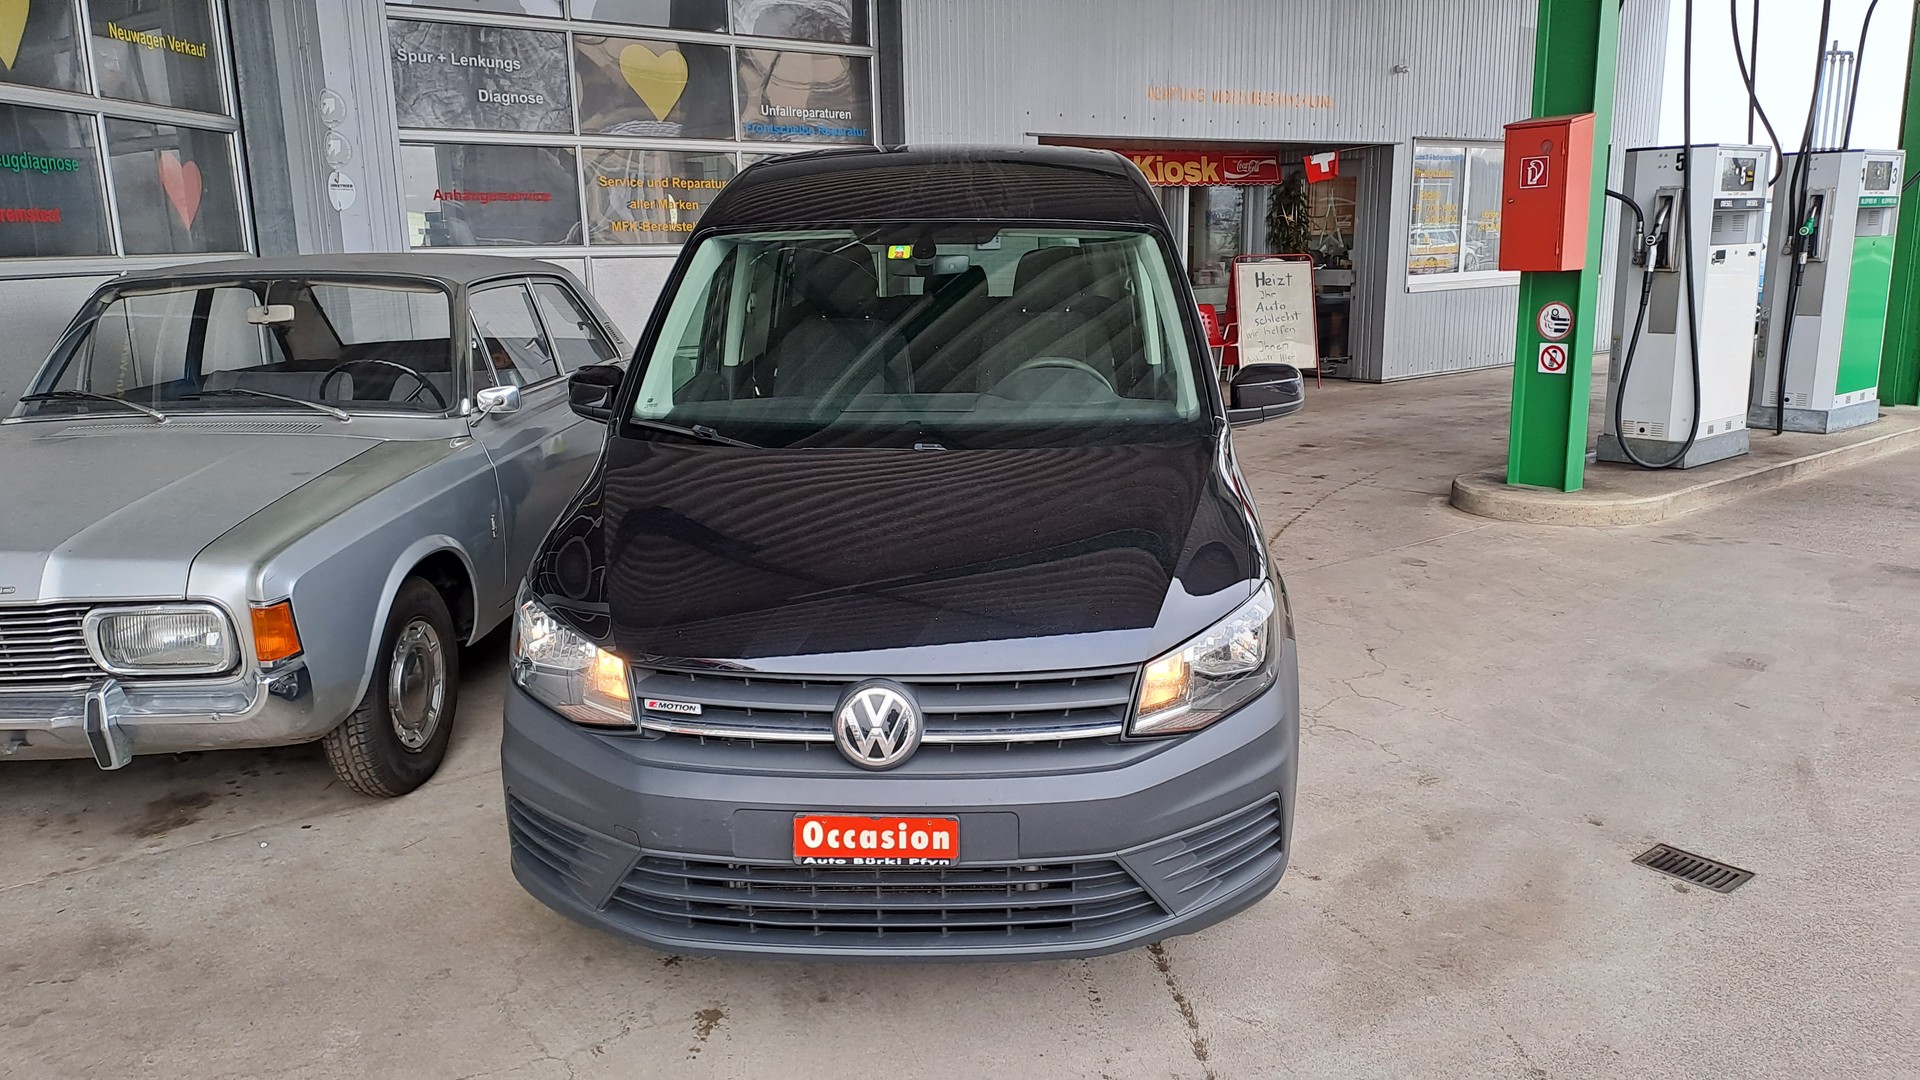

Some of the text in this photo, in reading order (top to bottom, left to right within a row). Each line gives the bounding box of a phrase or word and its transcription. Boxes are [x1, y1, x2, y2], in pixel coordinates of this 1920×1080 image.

[108, 21, 206, 58] Neuwagen Verkauf
[397, 48, 433, 65] Spur
[451, 52, 522, 72] Lenkungs
[478, 89, 544, 106] Diagnose
[760, 104, 852, 120] Unfallreparaturen
[0, 151, 80, 175] ugdiagnose
[1133, 155, 1221, 183] Kiosk
[1675, 152, 1685, 172] 5
[598, 175, 727, 191] Service und Reparatur
[630, 200, 699, 211] aller Marken
[1254, 271, 1293, 288] Heizt
[1255, 301, 1287, 313] Auto
[1254, 311, 1302, 327] schlecht
[1263, 325, 1296, 335] helfen
[802, 820, 950, 850] Occasion
[802, 857, 950, 866] Auto Bürki Pfyn
